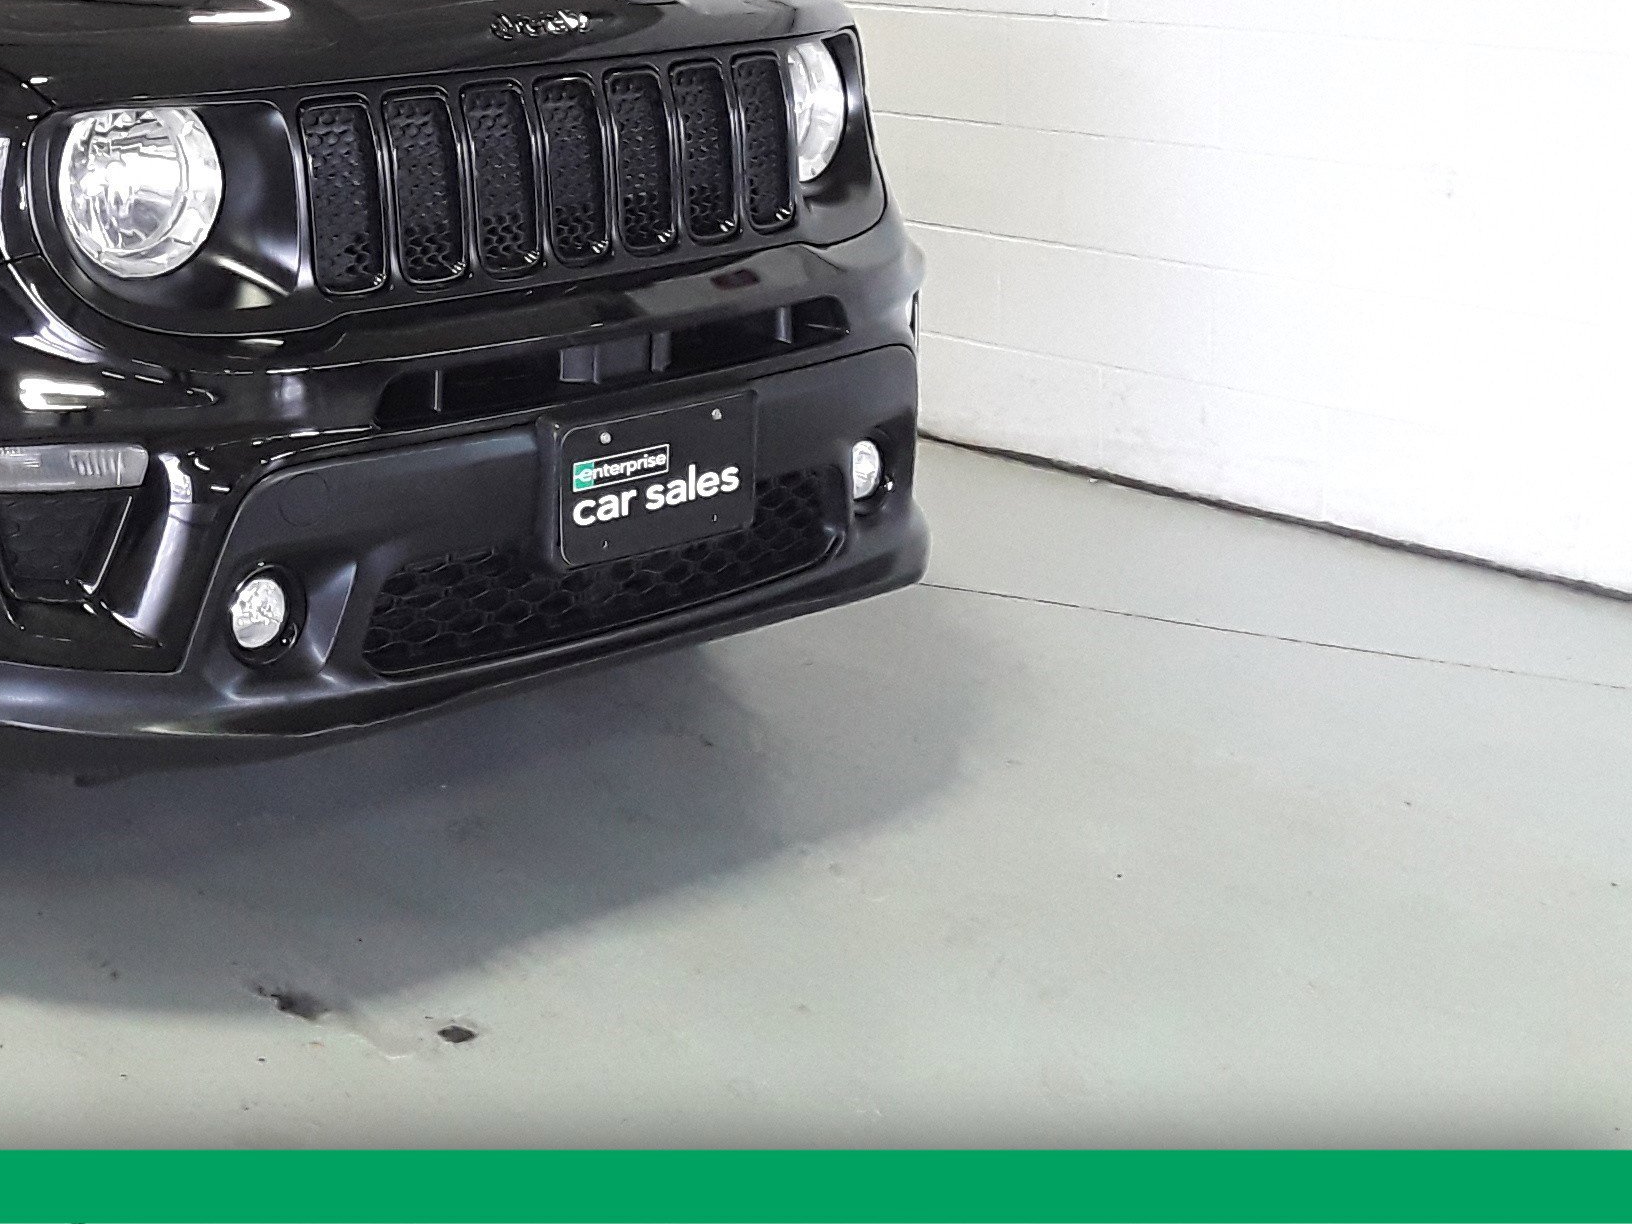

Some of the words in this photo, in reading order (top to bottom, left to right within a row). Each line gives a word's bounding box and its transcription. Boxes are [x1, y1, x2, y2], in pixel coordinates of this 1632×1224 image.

[577, 452, 667, 482] enterprise
[572, 488, 638, 527] car
[644, 463, 741, 511] sales
